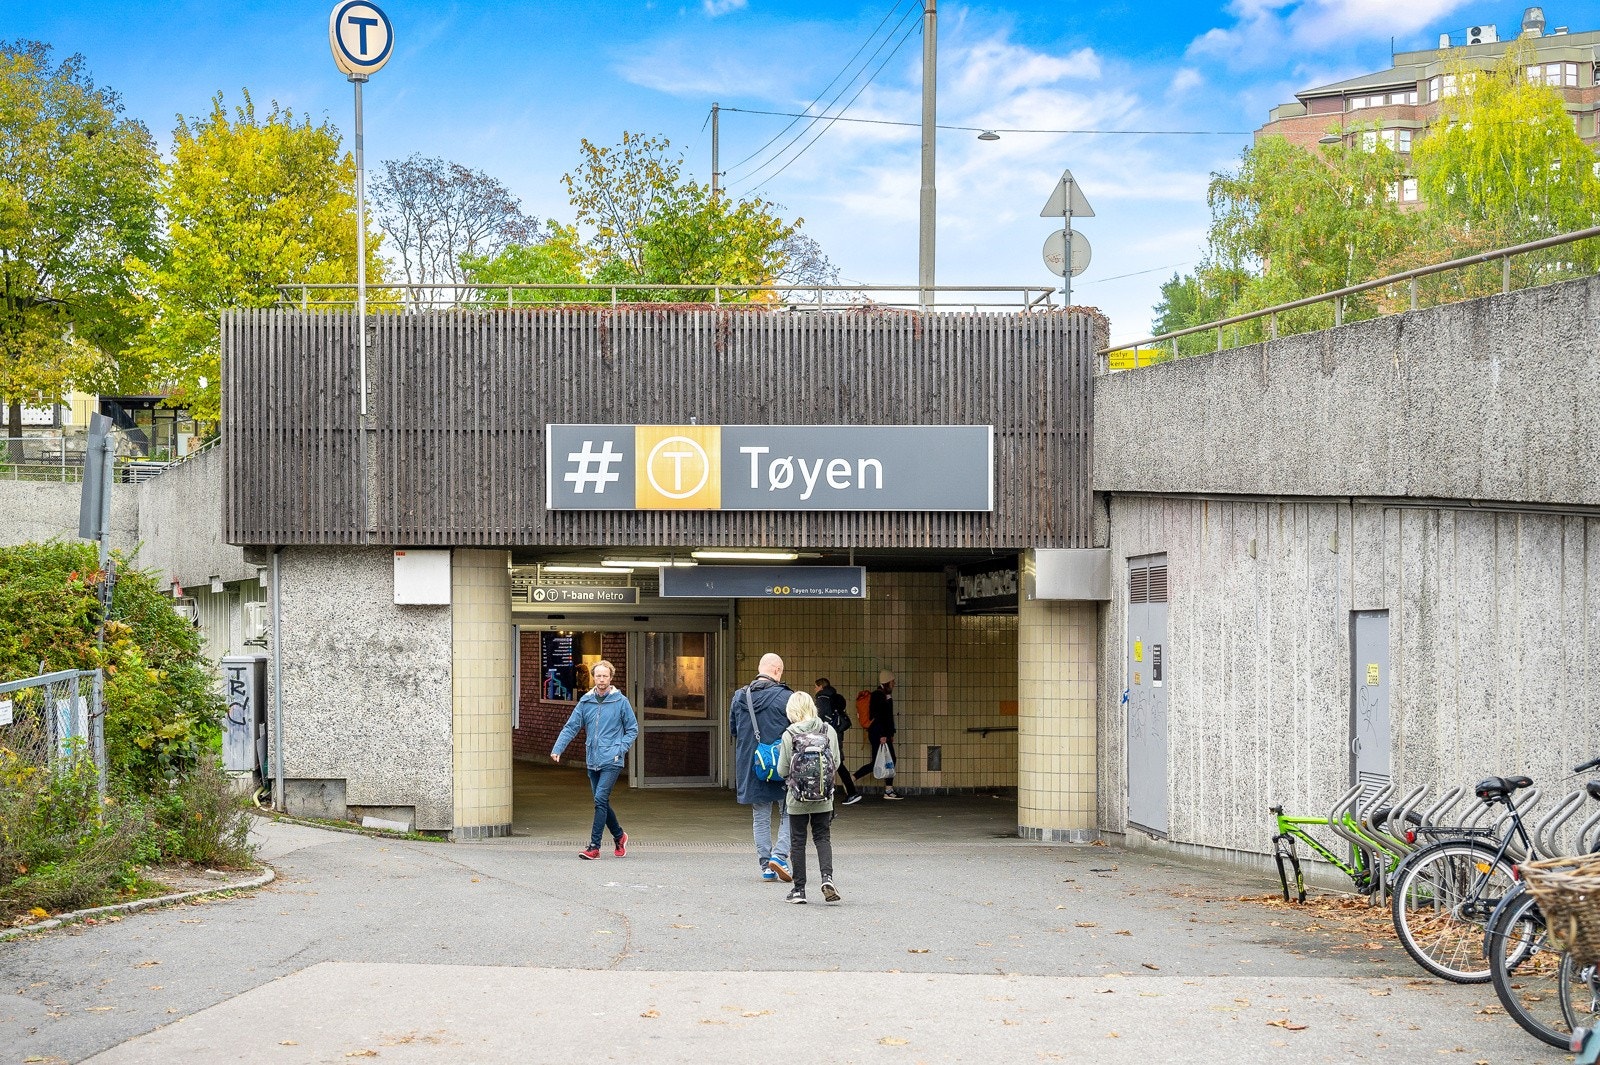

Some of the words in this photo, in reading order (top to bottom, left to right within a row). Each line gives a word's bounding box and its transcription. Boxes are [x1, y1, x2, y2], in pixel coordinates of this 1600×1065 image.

[348, 15, 378, 55] T
[1110, 351, 1128, 359] elsfyr
[662, 451, 694, 491] T
[739, 446, 883, 501] Tøyen
[562, 590, 594, 600] T-bane
[597, 590, 624, 600] Metro
[792, 587, 808, 595] Tøyen
[825, 587, 848, 595] Kampen
